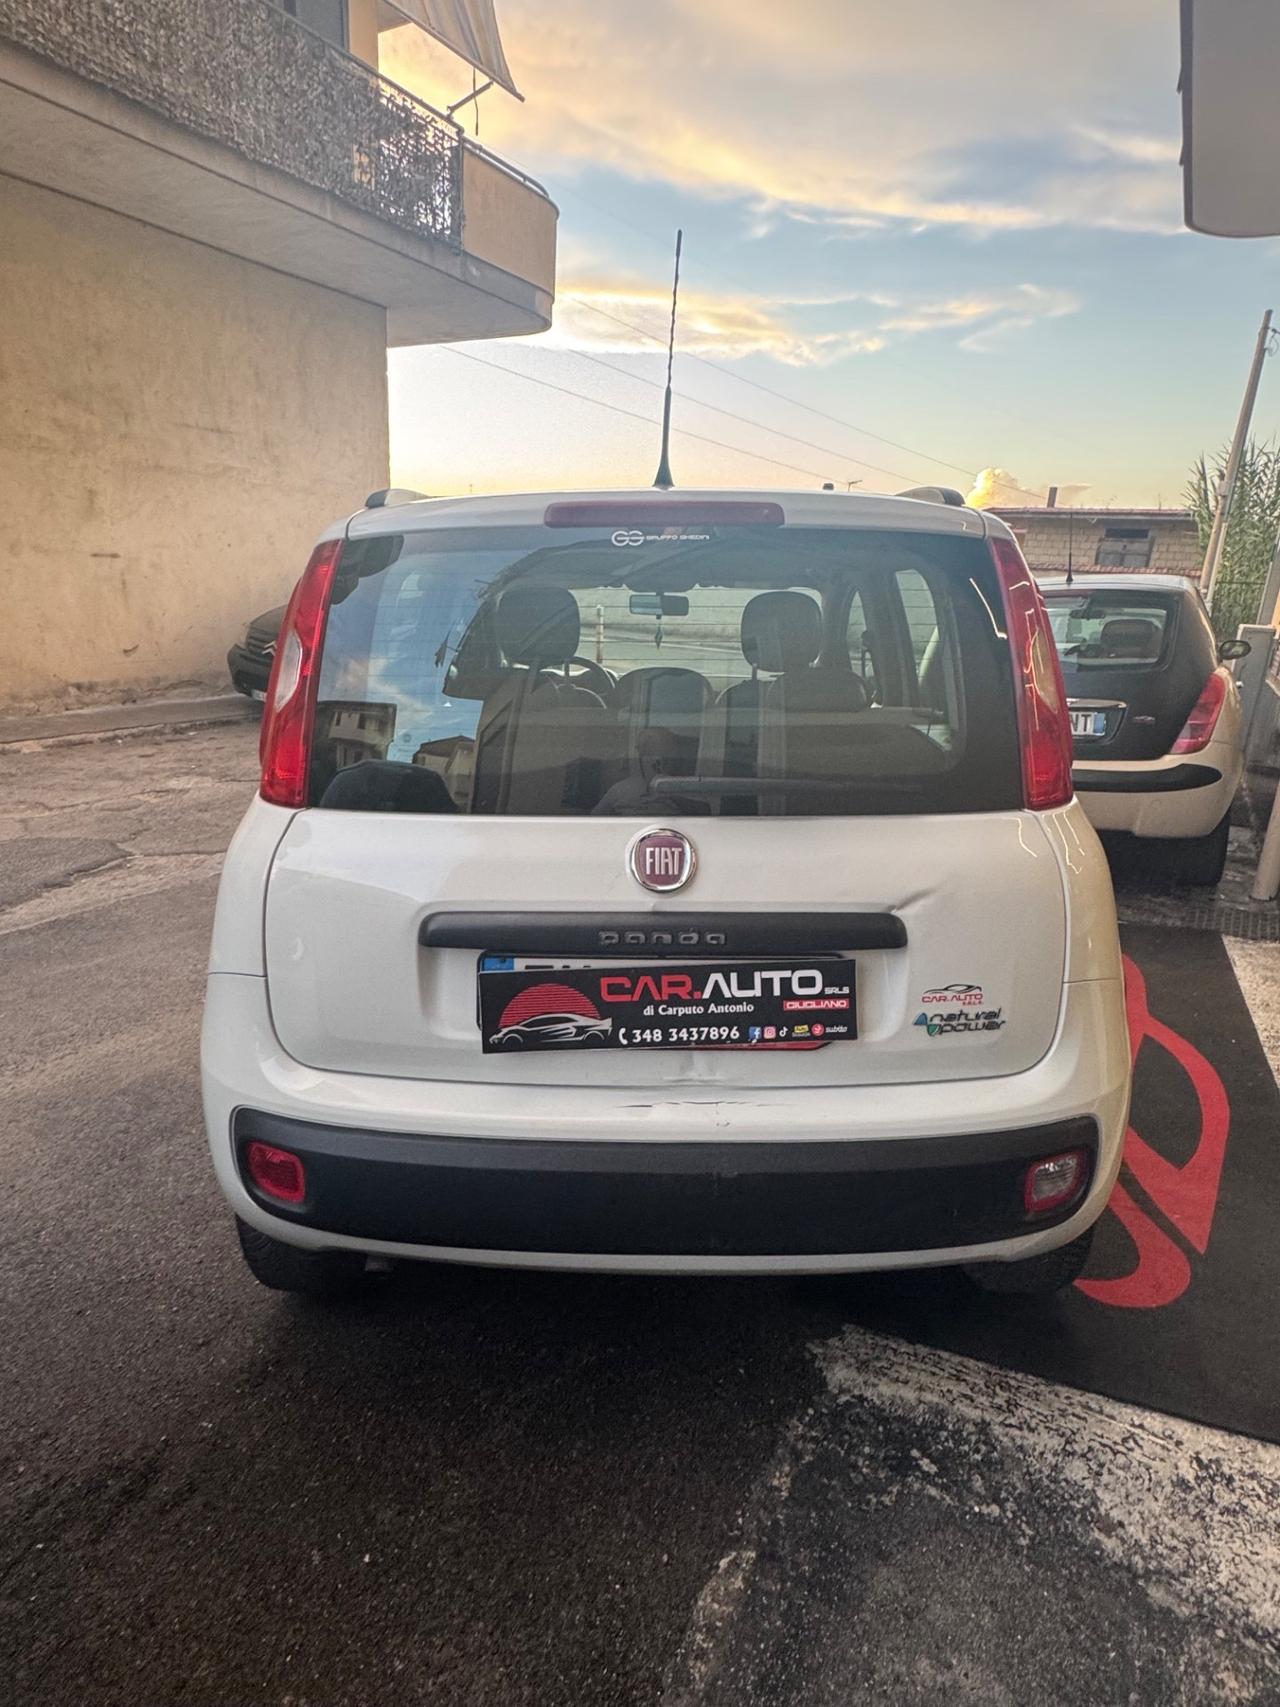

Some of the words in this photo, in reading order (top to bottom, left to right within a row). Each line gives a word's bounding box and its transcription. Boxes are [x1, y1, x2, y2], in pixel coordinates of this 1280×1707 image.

[645, 847, 682, 875] FIAT
[599, 928, 727, 945] panda
[786, 1000, 847, 1009] GIUGLIANO
[950, 993, 983, 1002] AUTO
[643, 1004, 655, 1016] di
[658, 1003, 705, 1017] Carputo
[707, 1001, 755, 1014] Antonio
[929, 1007, 1002, 1022] natural
[632, 1029, 663, 1043] 348
[668, 1026, 740, 1042] 3437896
[938, 1020, 1006, 1035] power
